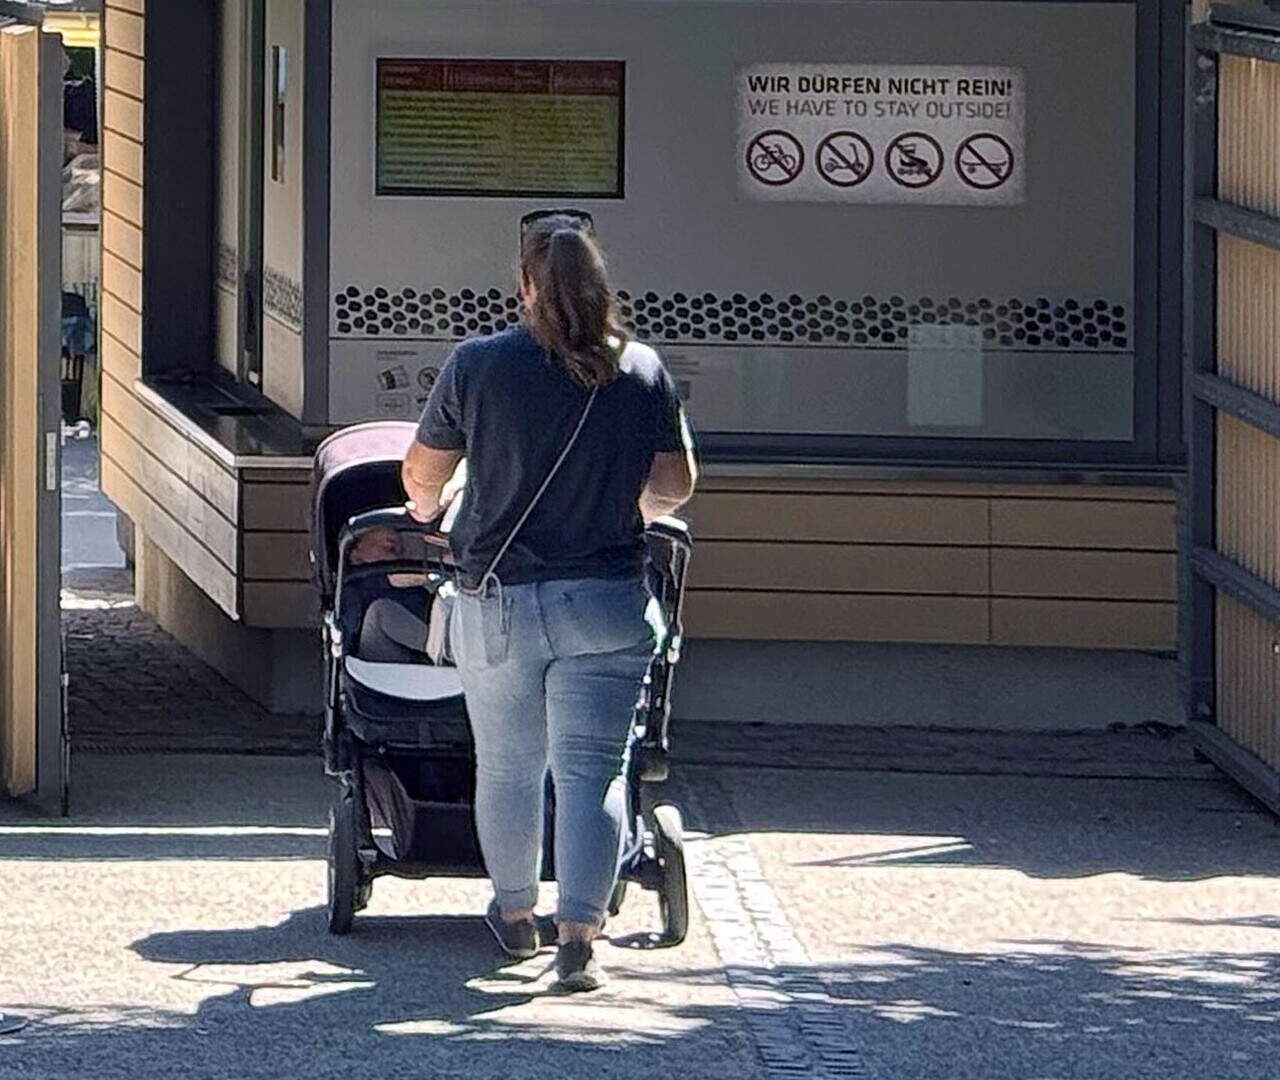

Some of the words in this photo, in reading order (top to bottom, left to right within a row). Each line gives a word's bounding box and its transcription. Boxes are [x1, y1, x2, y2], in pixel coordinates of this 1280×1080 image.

[747, 76, 790, 93] WIR
[798, 74, 880, 94] DÜRFEN
[888, 78, 950, 95] NICHT
[956, 78, 1012, 96] REIN!
[748, 99, 779, 115] WE
[786, 99, 836, 116] HAVE
[843, 100, 867, 117] TO
[873, 100, 919, 118] STAY
[925, 100, 1011, 119] OUTSIDE!
